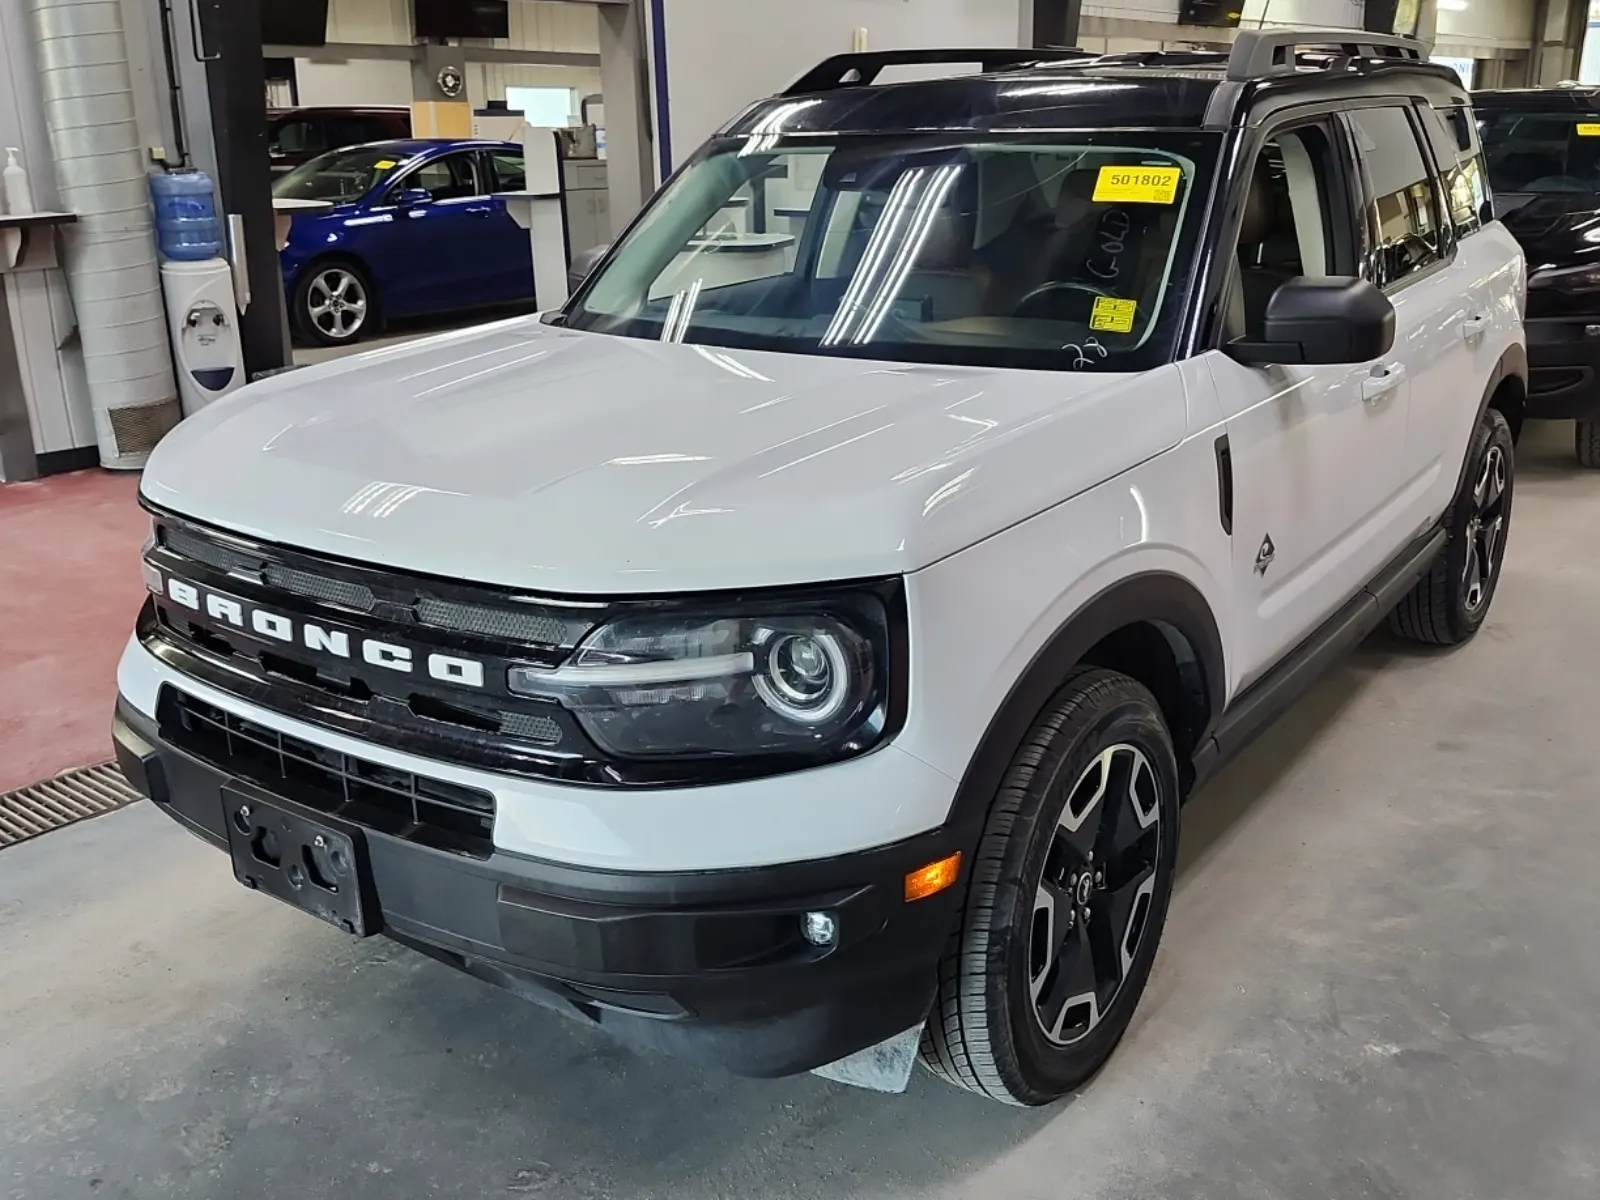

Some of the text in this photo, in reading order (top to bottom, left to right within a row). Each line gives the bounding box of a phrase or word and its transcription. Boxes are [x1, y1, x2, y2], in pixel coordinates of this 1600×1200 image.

[1110, 174, 1172, 187] 501802
[1085, 209, 1130, 278] GOLD
[168, 578, 485, 687] BRONCO
